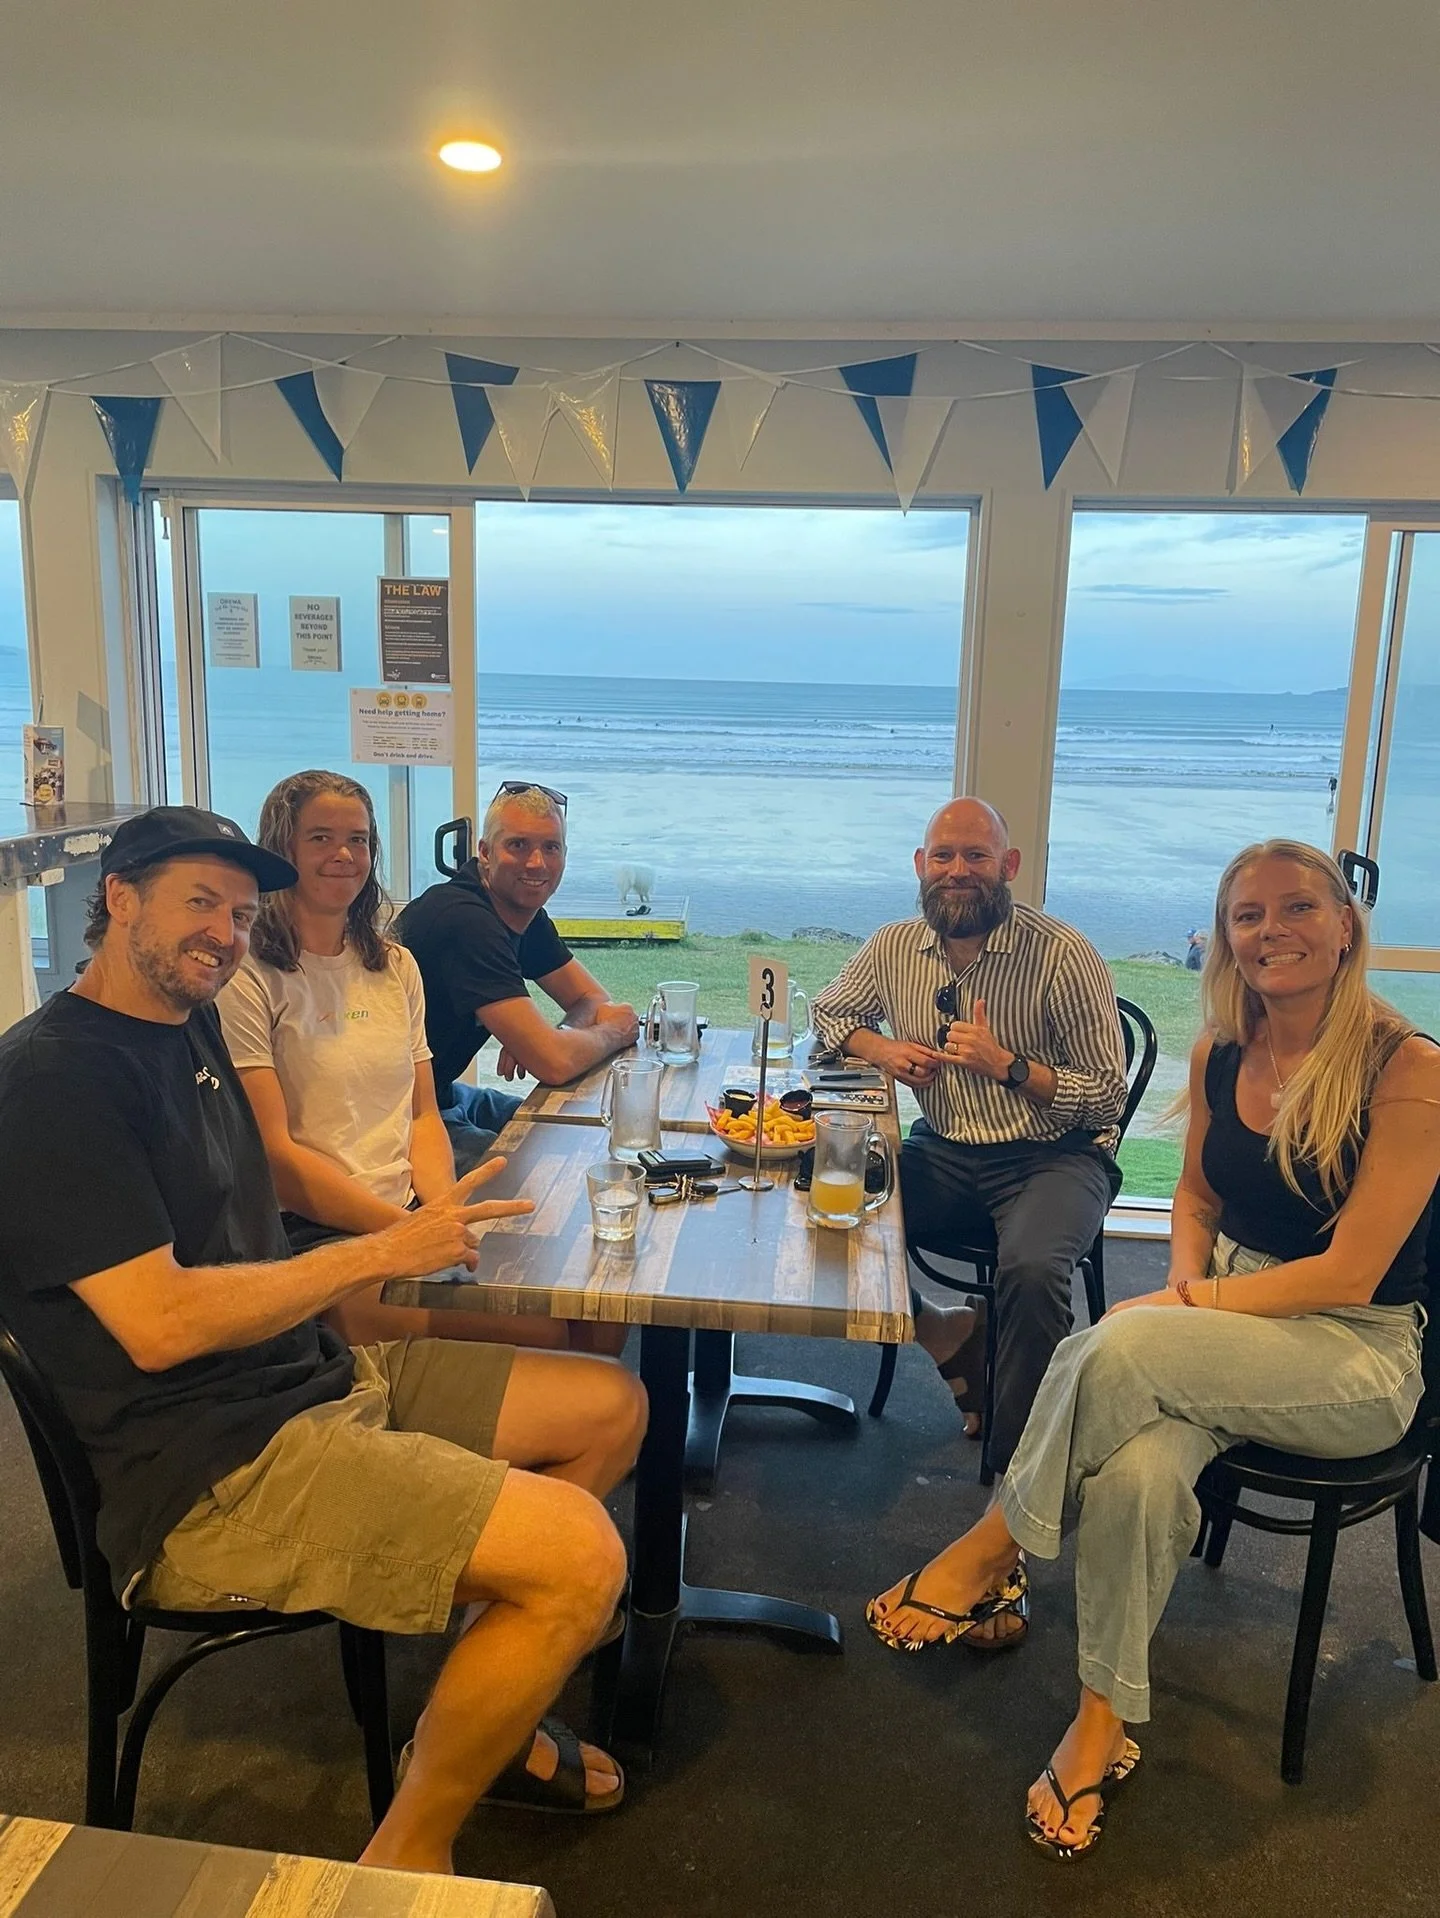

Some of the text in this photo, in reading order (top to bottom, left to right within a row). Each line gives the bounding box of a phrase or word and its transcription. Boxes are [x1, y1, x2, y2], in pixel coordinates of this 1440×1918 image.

[385, 584, 441, 596] THE LAW
[377, 709, 393, 717] help
[394, 710, 421, 718] getting
[762, 967, 775, 1009] 3
